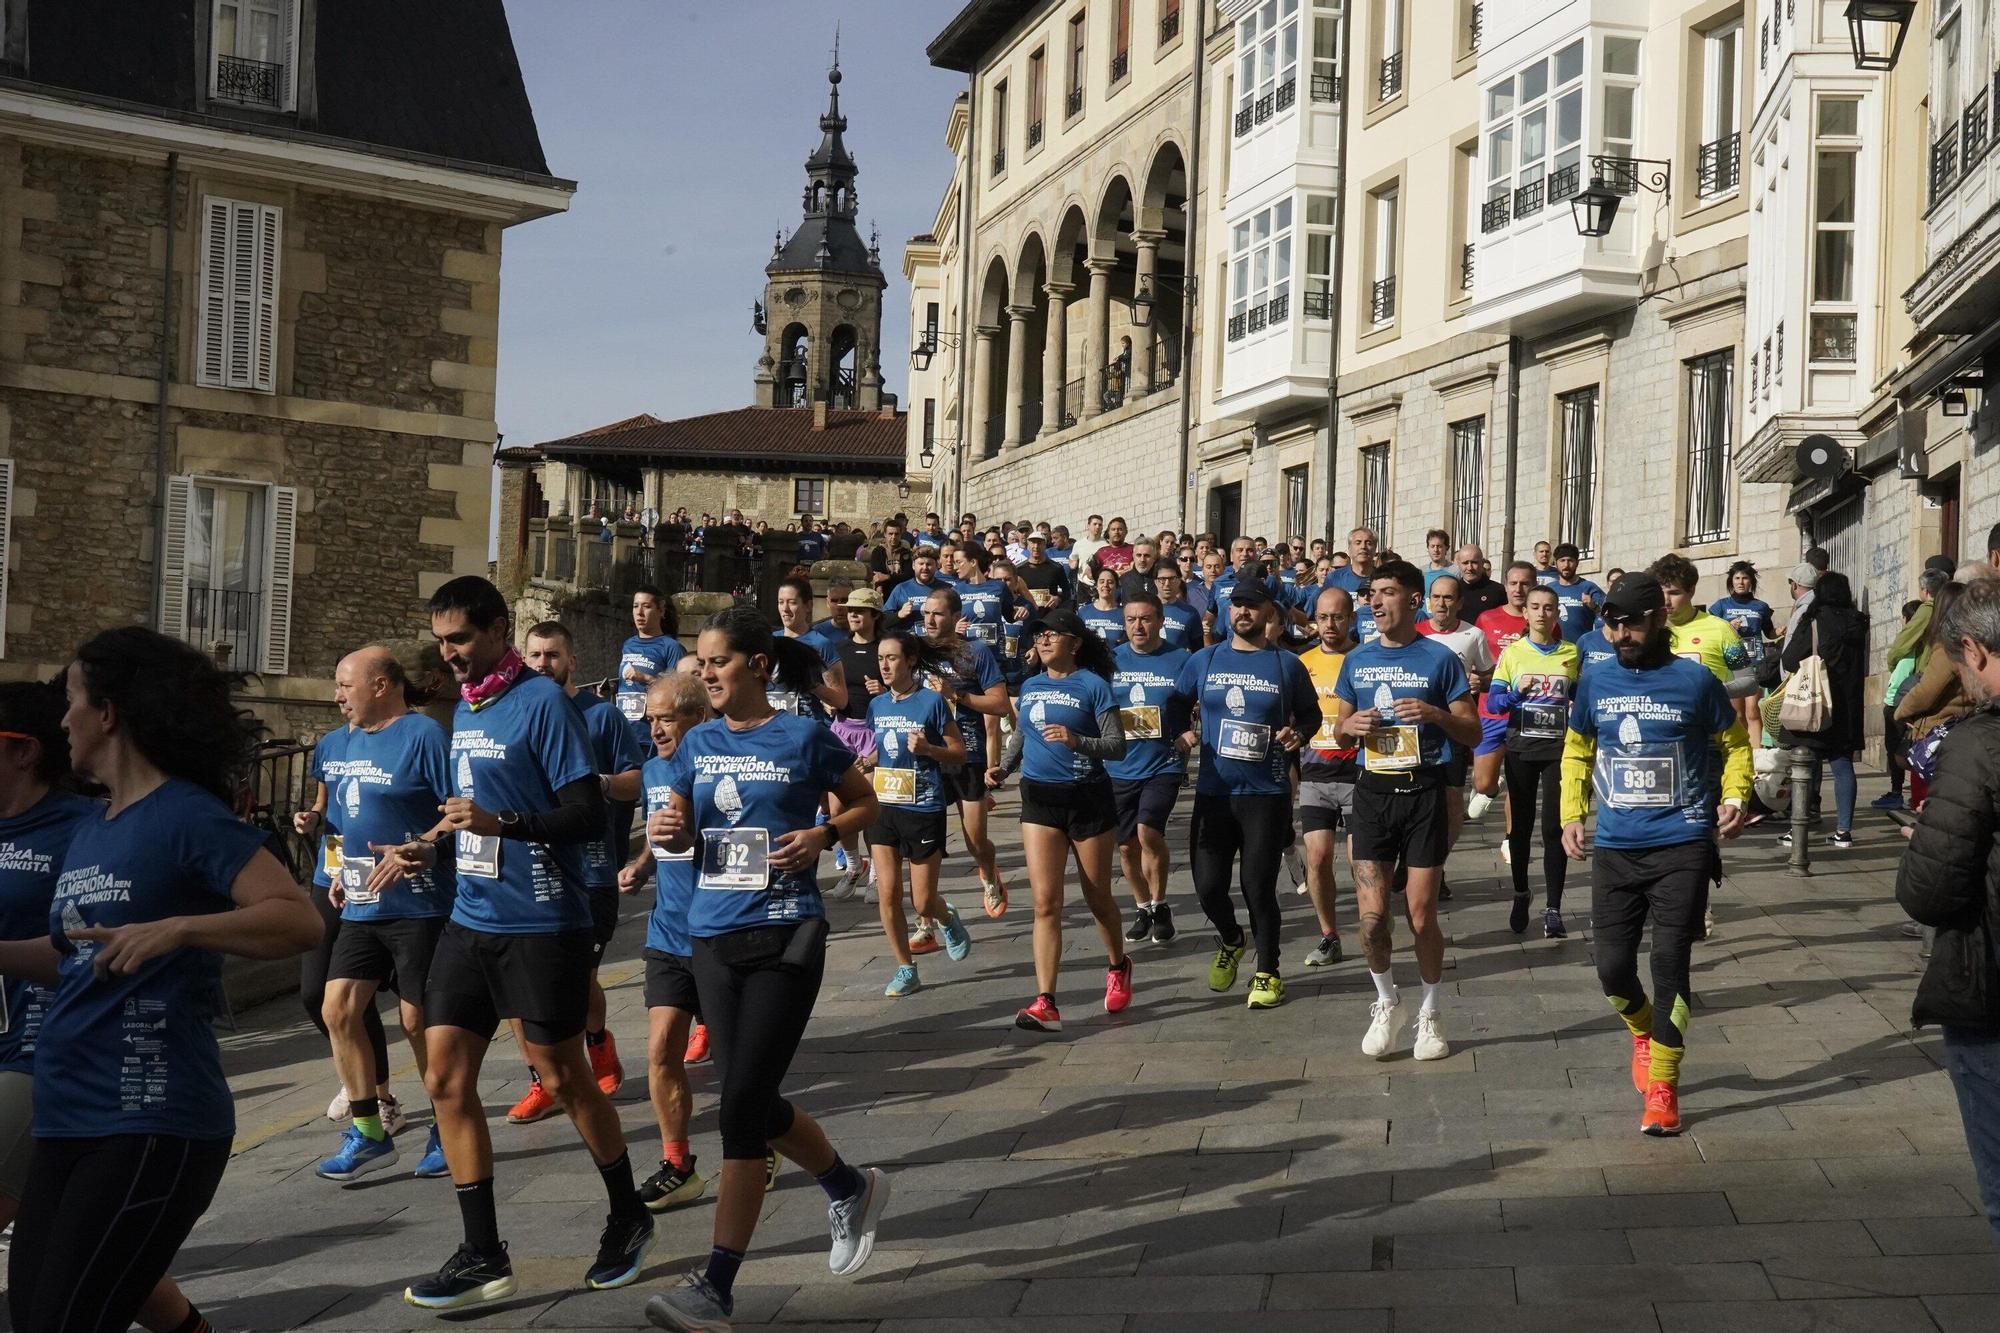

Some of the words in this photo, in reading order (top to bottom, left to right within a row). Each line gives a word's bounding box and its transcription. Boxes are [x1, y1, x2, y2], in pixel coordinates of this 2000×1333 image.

[1930, 496, 1936, 507] 2
[1216, 678, 1269, 686] ALMENDRA
[1363, 672, 1417, 681] ALMENDRA
[1606, 696, 1651, 704] CONQUISTA
[1607, 703, 1670, 713] ALMENDRA
[1638, 713, 1682, 722] KONKISTA
[1231, 730, 1258, 747] 886
[1376, 736, 1405, 753] 603
[469, 749, 506, 760] KONKISTA
[702, 756, 757, 764] CONQUISTA
[702, 761, 776, 774] ALMENDRA
[737, 772, 790, 783] KONKISTA
[883, 776, 903, 790] 227
[1623, 770, 1656, 788] 938
[459, 830, 482, 854] 978
[716, 843, 750, 867] 962
[0, 861, 50, 873] ONKISTA
[54, 873, 114, 900] ALMENDRA
[114, 880, 132, 888] REN
[78, 889, 131, 905] KONKISTA
